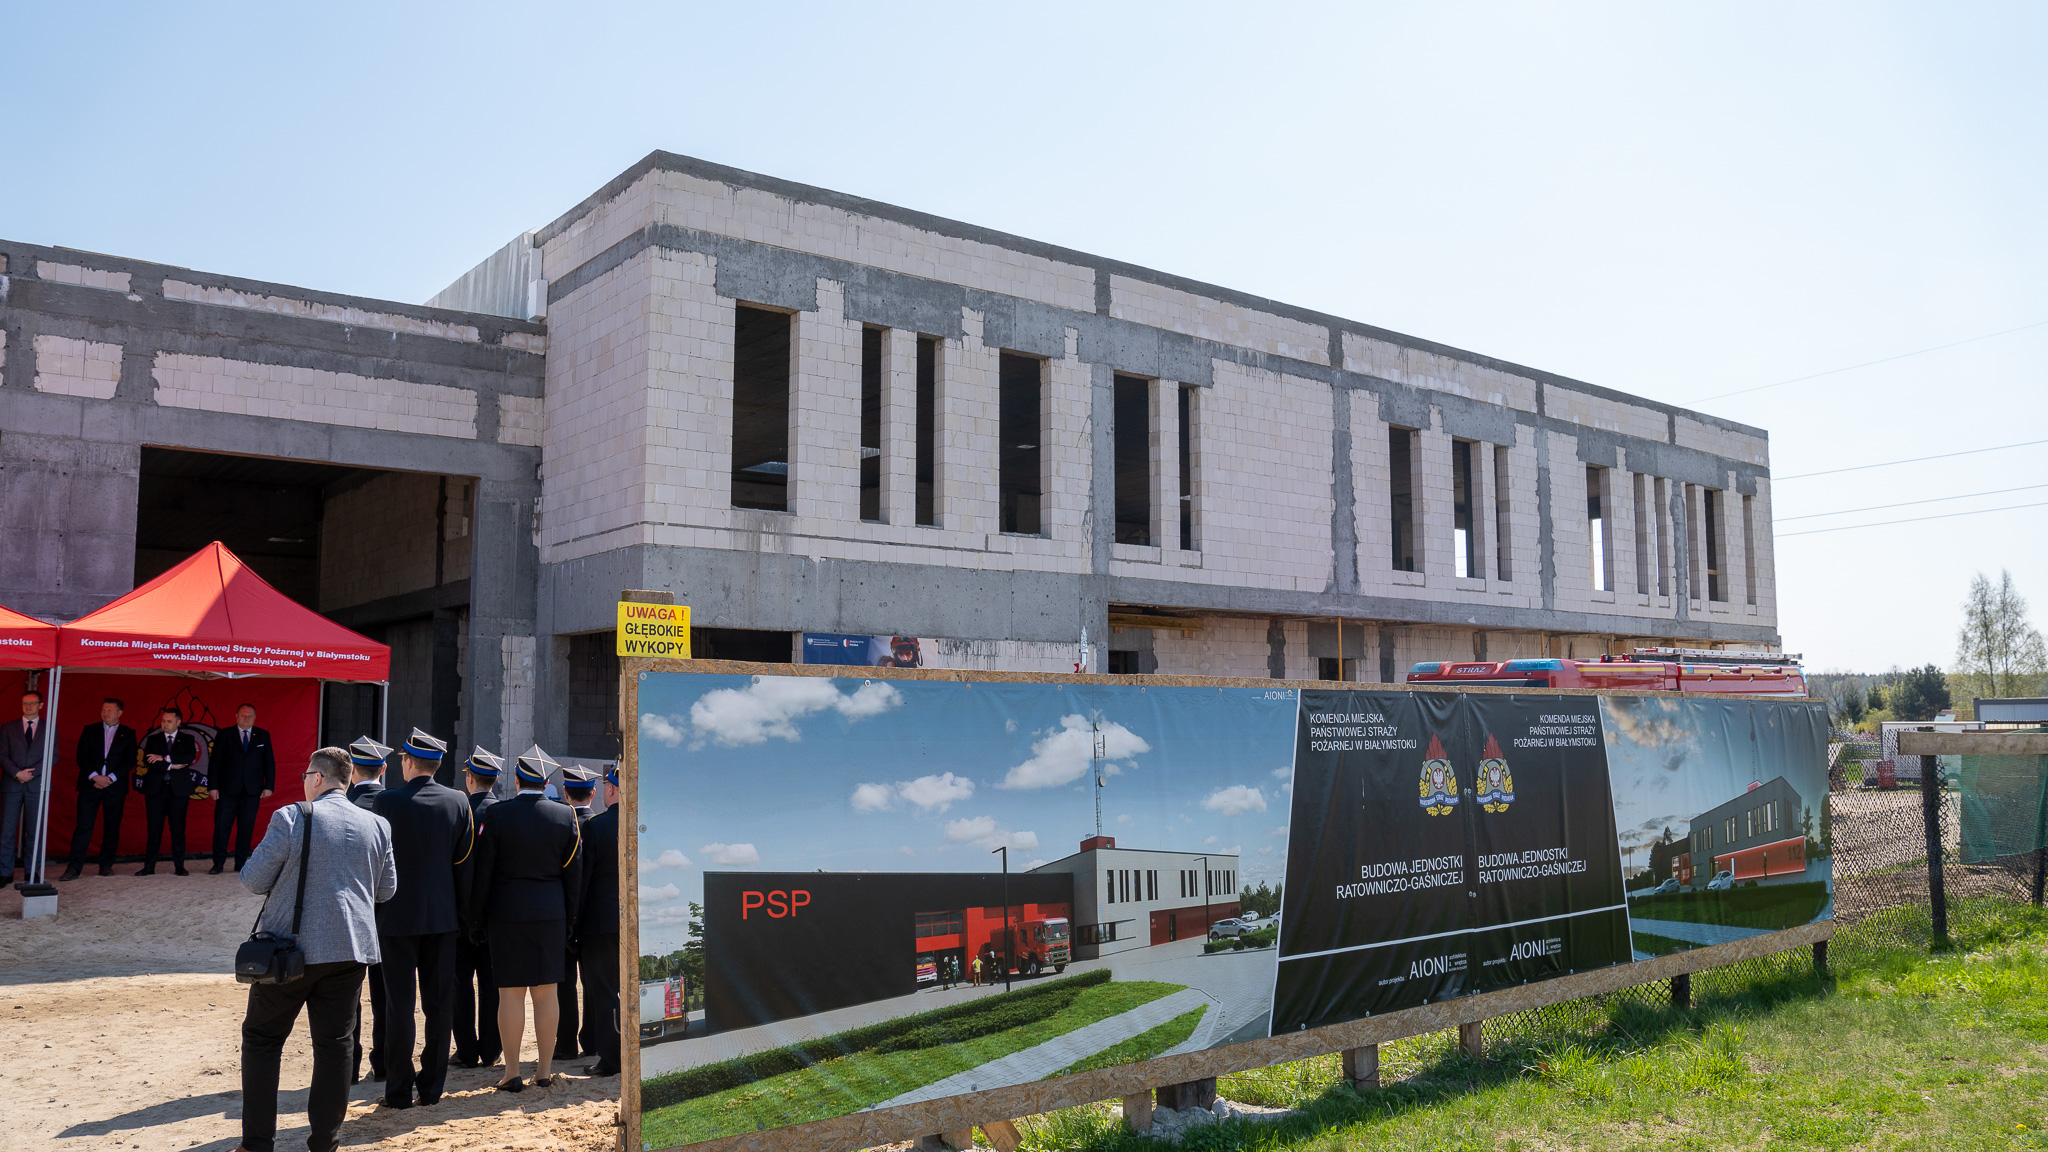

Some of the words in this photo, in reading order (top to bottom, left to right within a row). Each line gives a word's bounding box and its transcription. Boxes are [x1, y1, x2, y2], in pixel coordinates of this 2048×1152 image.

[627, 606, 676, 620] UWAGA
[681, 610, 685, 621] !
[625, 623, 684, 638] GŁĘBOKIE
[80, 638, 129, 648] Komenda
[131, 641, 170, 650] Miejska
[172, 642, 231, 653] Państwowej
[232, 644, 263, 655] Straży
[264, 646, 304, 658] Pożarnej
[316, 650, 371, 661] Białymstoku
[625, 640, 684, 654] WYKOPY
[153, 653, 306, 668] www.bialystok.straz.bialystok.pl
[1264, 691, 1286, 700] AIONI
[1309, 713, 1351, 724] KOMENDA
[1351, 713, 1385, 724] MIEJSKA
[1539, 714, 1570, 724] KOMENDA
[1570, 714, 1596, 724] MIEJSKA
[1310, 725, 1367, 738] PAŃSTWOWEJ
[1367, 725, 1398, 737] STRAŻY
[1529, 725, 1573, 736] PAŃSTWOWEJ
[1573, 725, 1596, 735] STRAŻY
[1311, 739, 1354, 751] POŻARNEJ
[1355, 740, 1363, 750] W
[1364, 739, 1417, 750] BIAŁYMSTOKU
[1513, 737, 1547, 748] POŻARNEJ
[1547, 738, 1555, 747] W
[1555, 737, 1597, 747] BIAŁYMSTOKU
[1478, 852, 1519, 868] BUDOWA
[1520, 847, 1568, 864] JEDNOSTKI
[1361, 863, 1408, 879] BUDOWA
[1409, 855, 1463, 873] JEDNOSTKI
[1479, 860, 1587, 884] RATOWNICZO-GAŚNICZEJ
[1336, 871, 1464, 899] RATOWNICZO-GAŚNICZEJ
[743, 890, 811, 920] PSP
[1510, 939, 1545, 961] AIONI
[1409, 955, 1449, 980] AIONI
